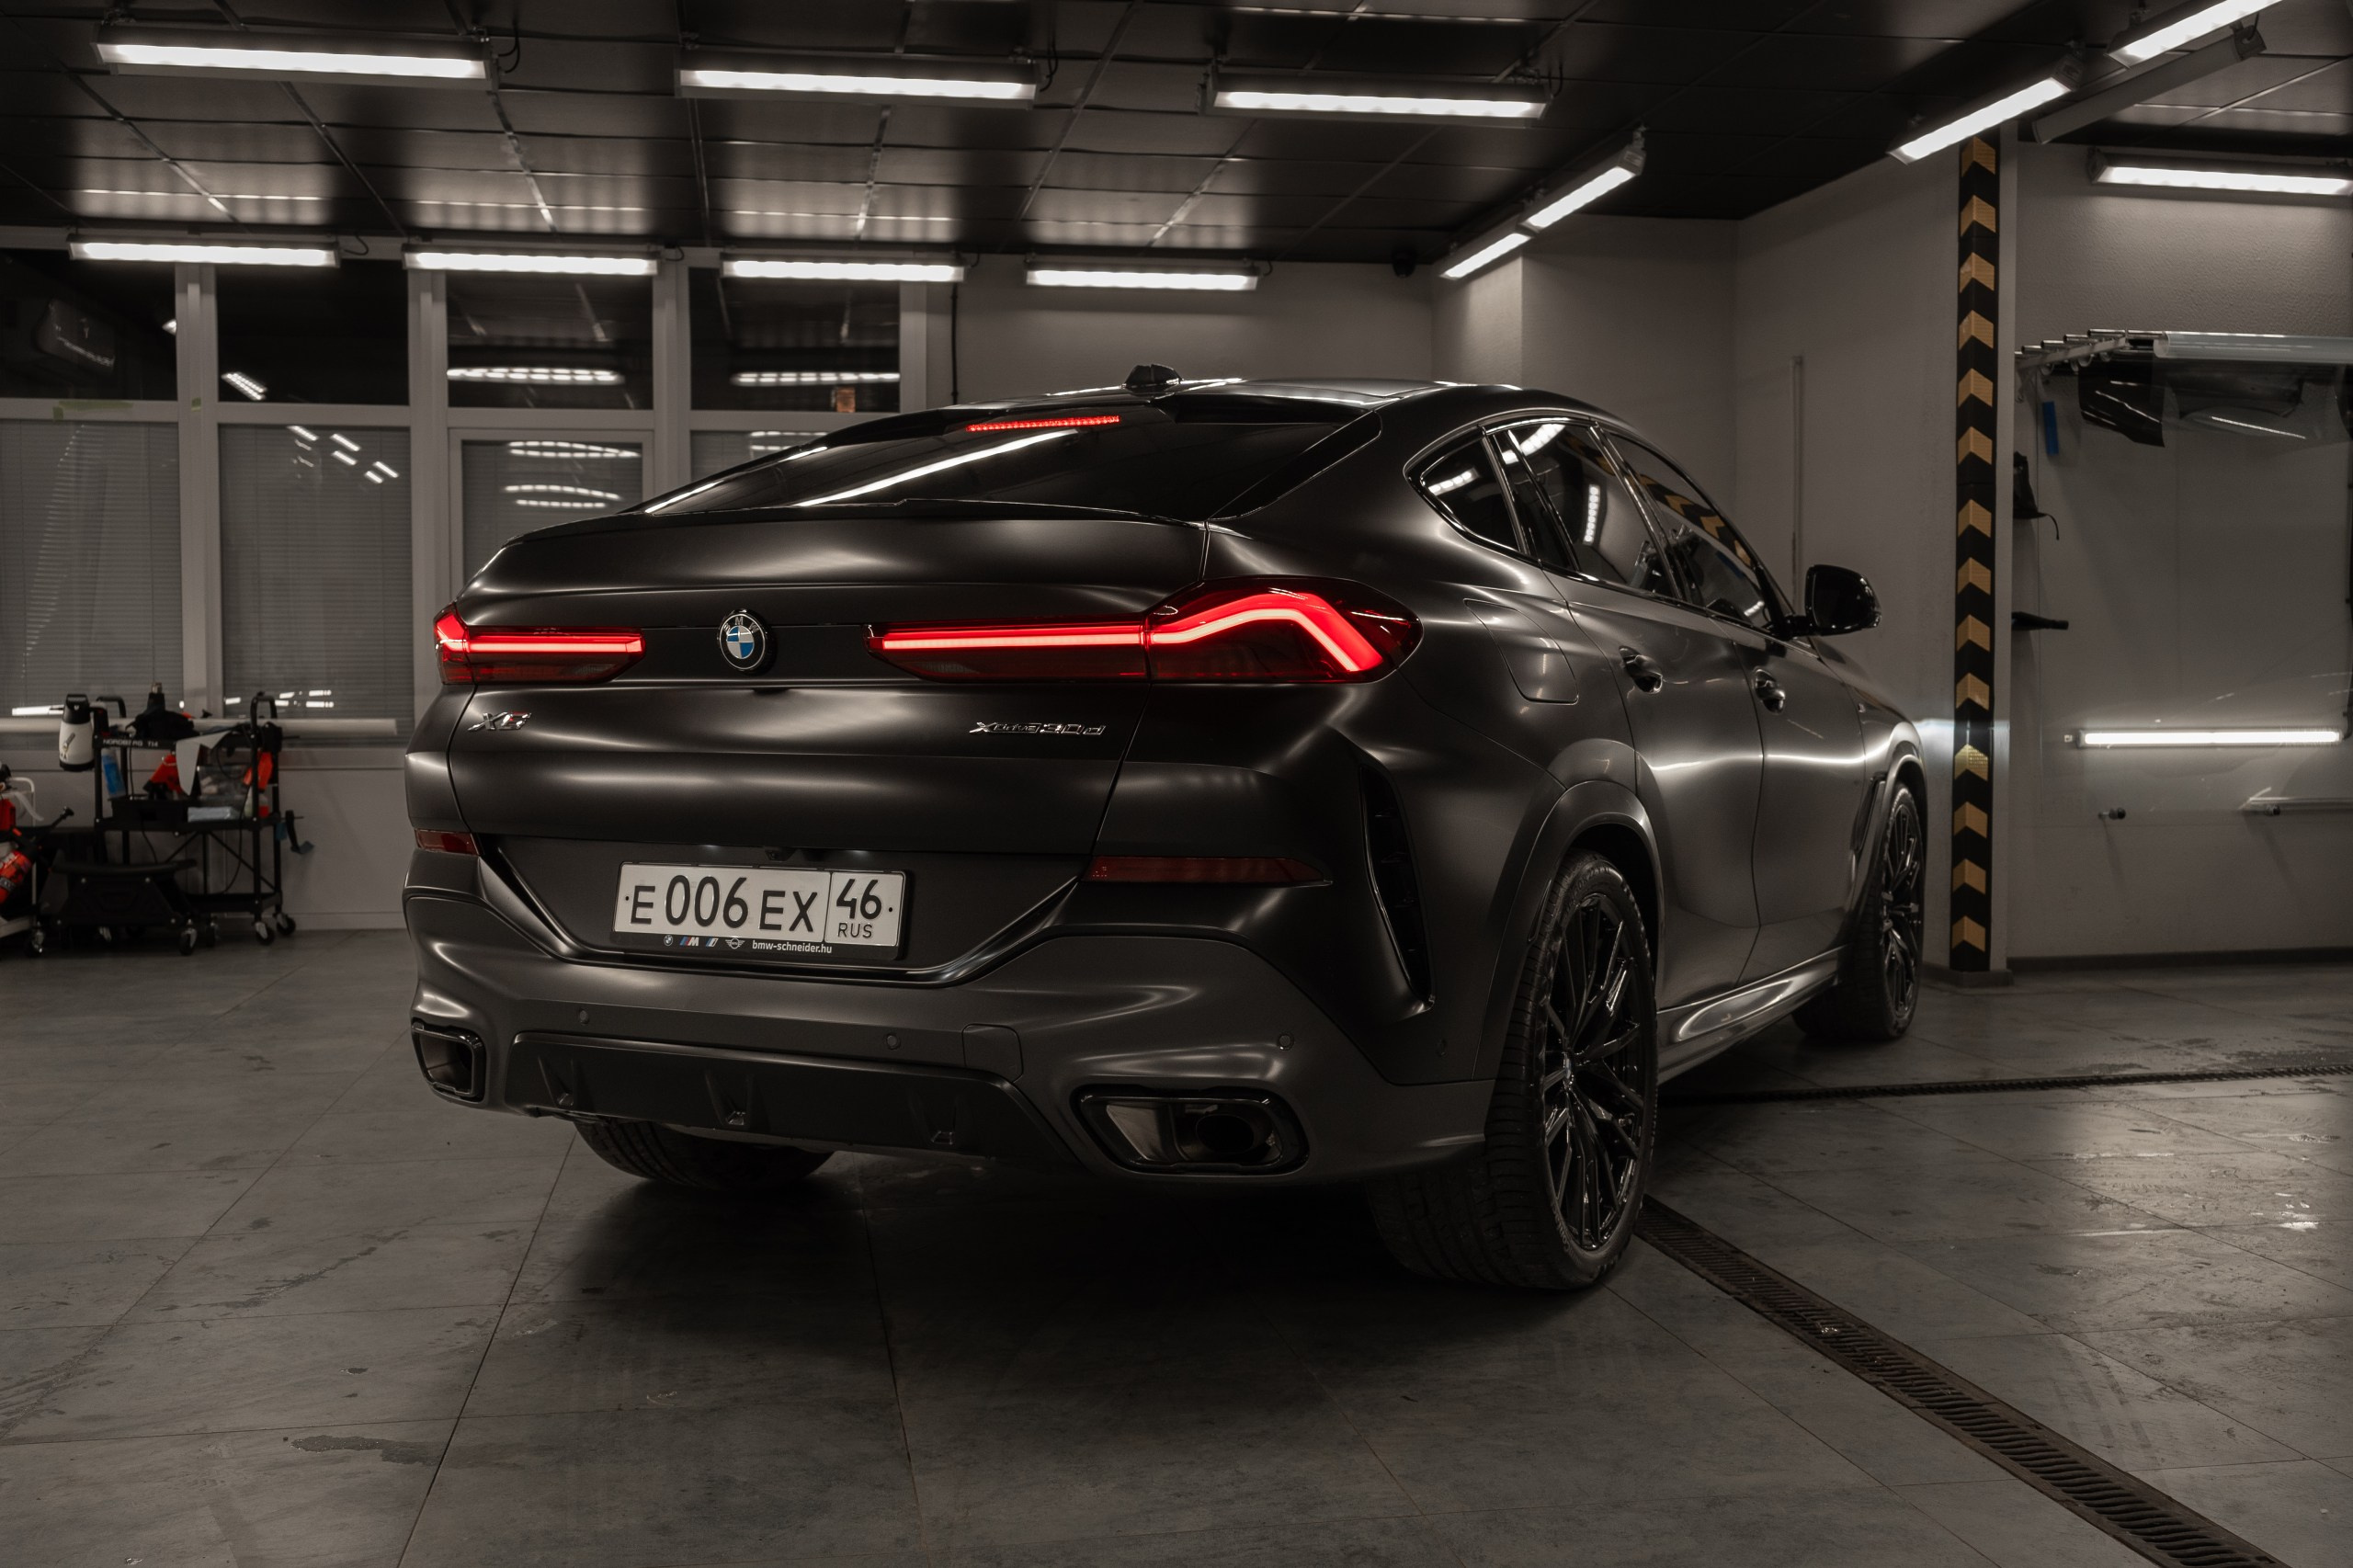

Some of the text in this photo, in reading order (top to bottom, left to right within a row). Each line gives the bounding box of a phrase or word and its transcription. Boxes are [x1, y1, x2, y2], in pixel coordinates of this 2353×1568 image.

[836, 878, 882, 920] 46
[837, 922, 872, 938] RUS
[752, 939, 833, 954] bmw-schneider.hu
